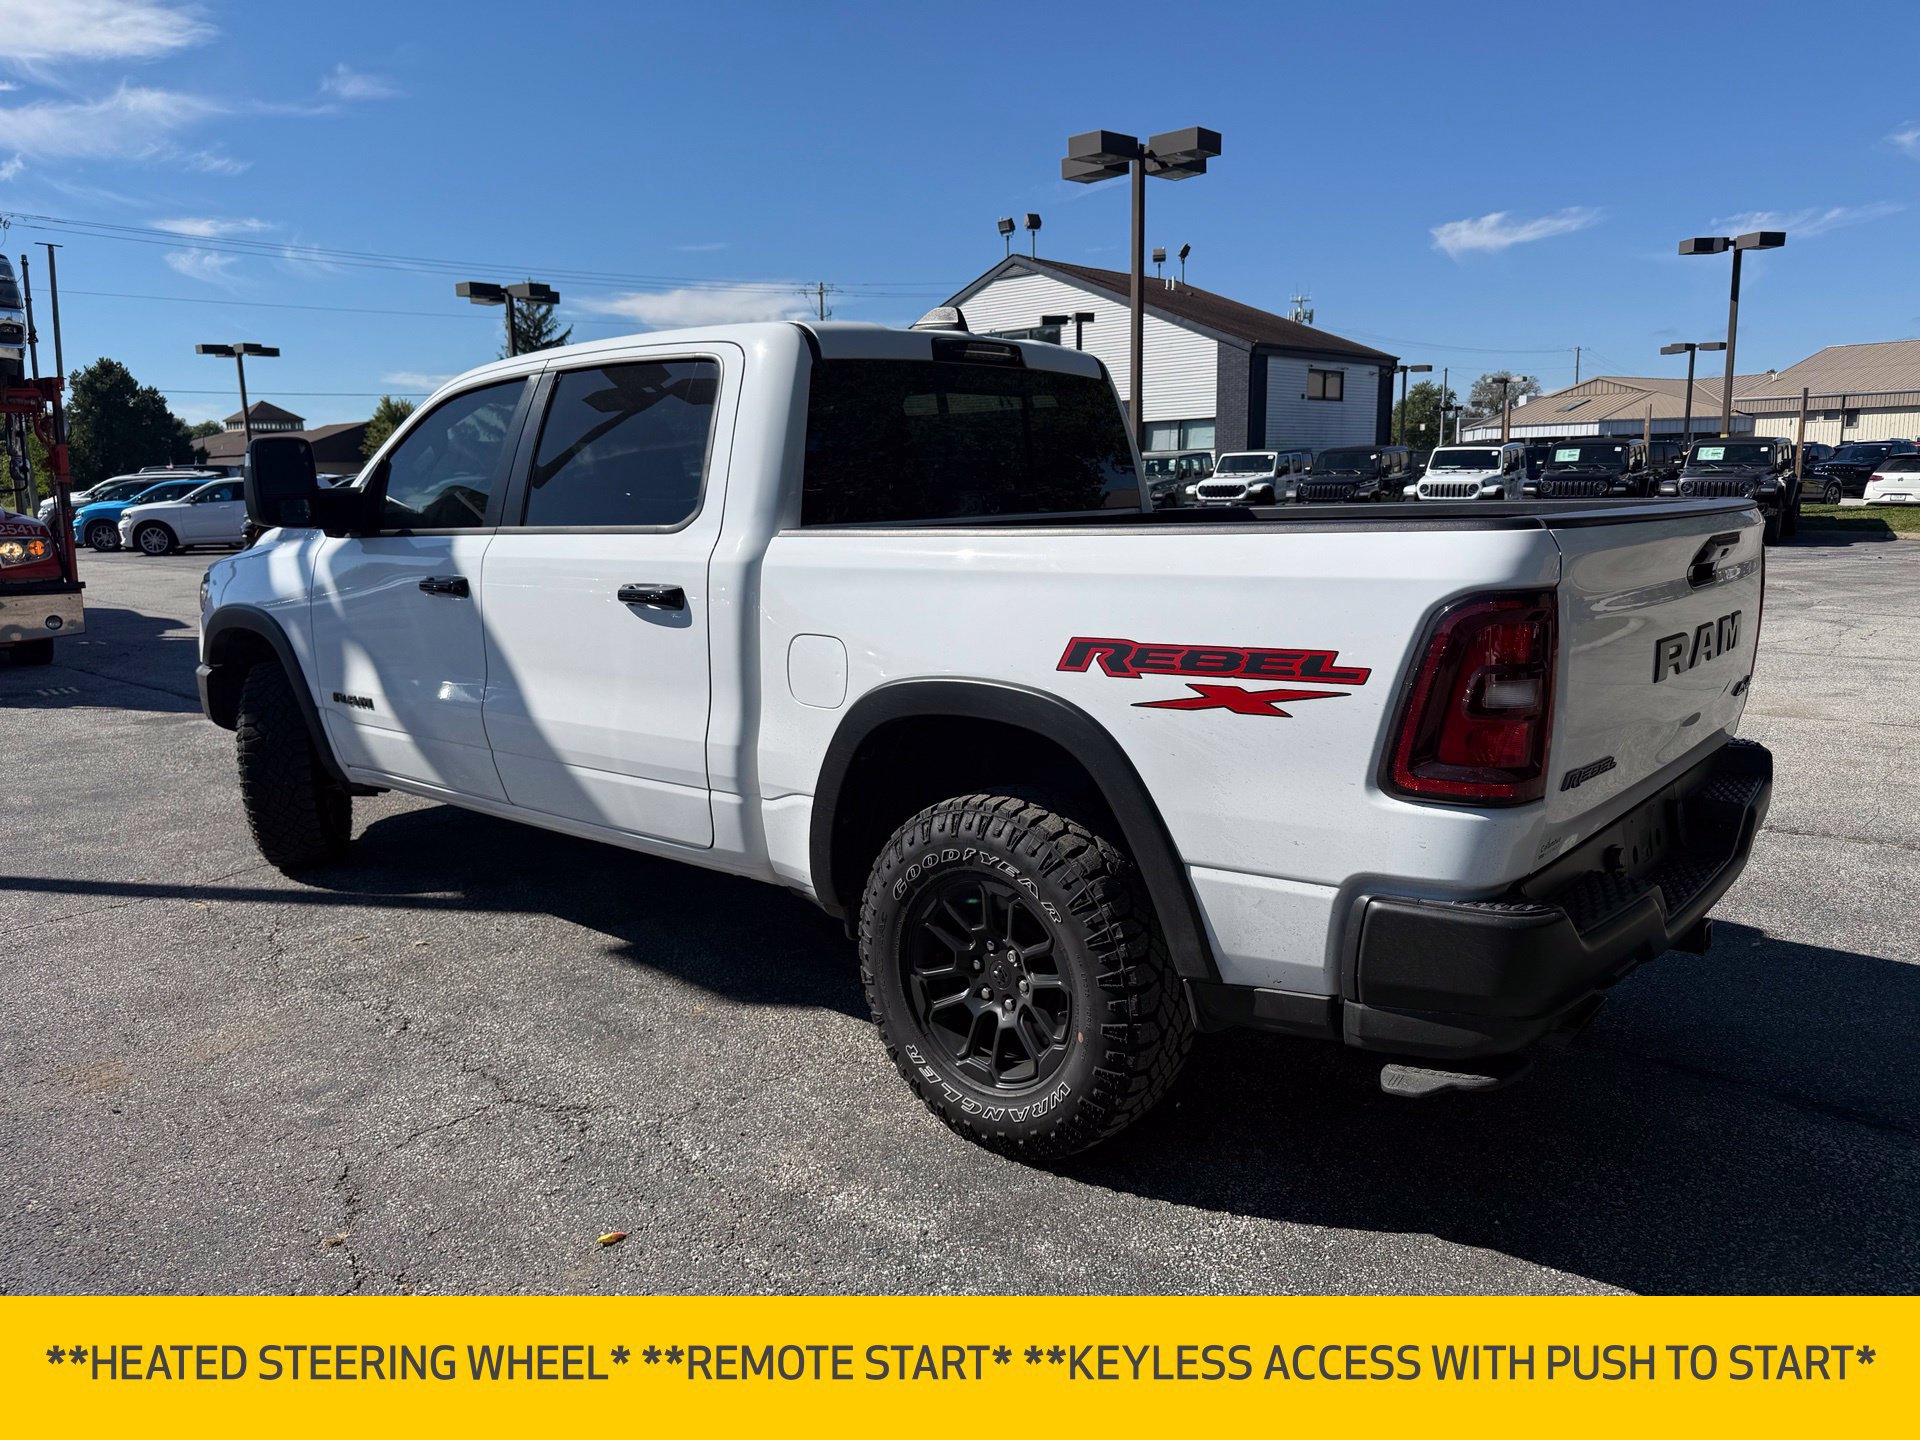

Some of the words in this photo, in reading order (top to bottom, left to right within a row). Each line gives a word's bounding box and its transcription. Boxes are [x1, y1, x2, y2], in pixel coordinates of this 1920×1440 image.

[1057, 637, 1371, 685] REBEL
[1655, 610, 1741, 683] RAM
[1131, 684, 1351, 717] X
[1560, 755, 1616, 792] REBEL
[906, 1043, 1071, 1122] WRANGLER
